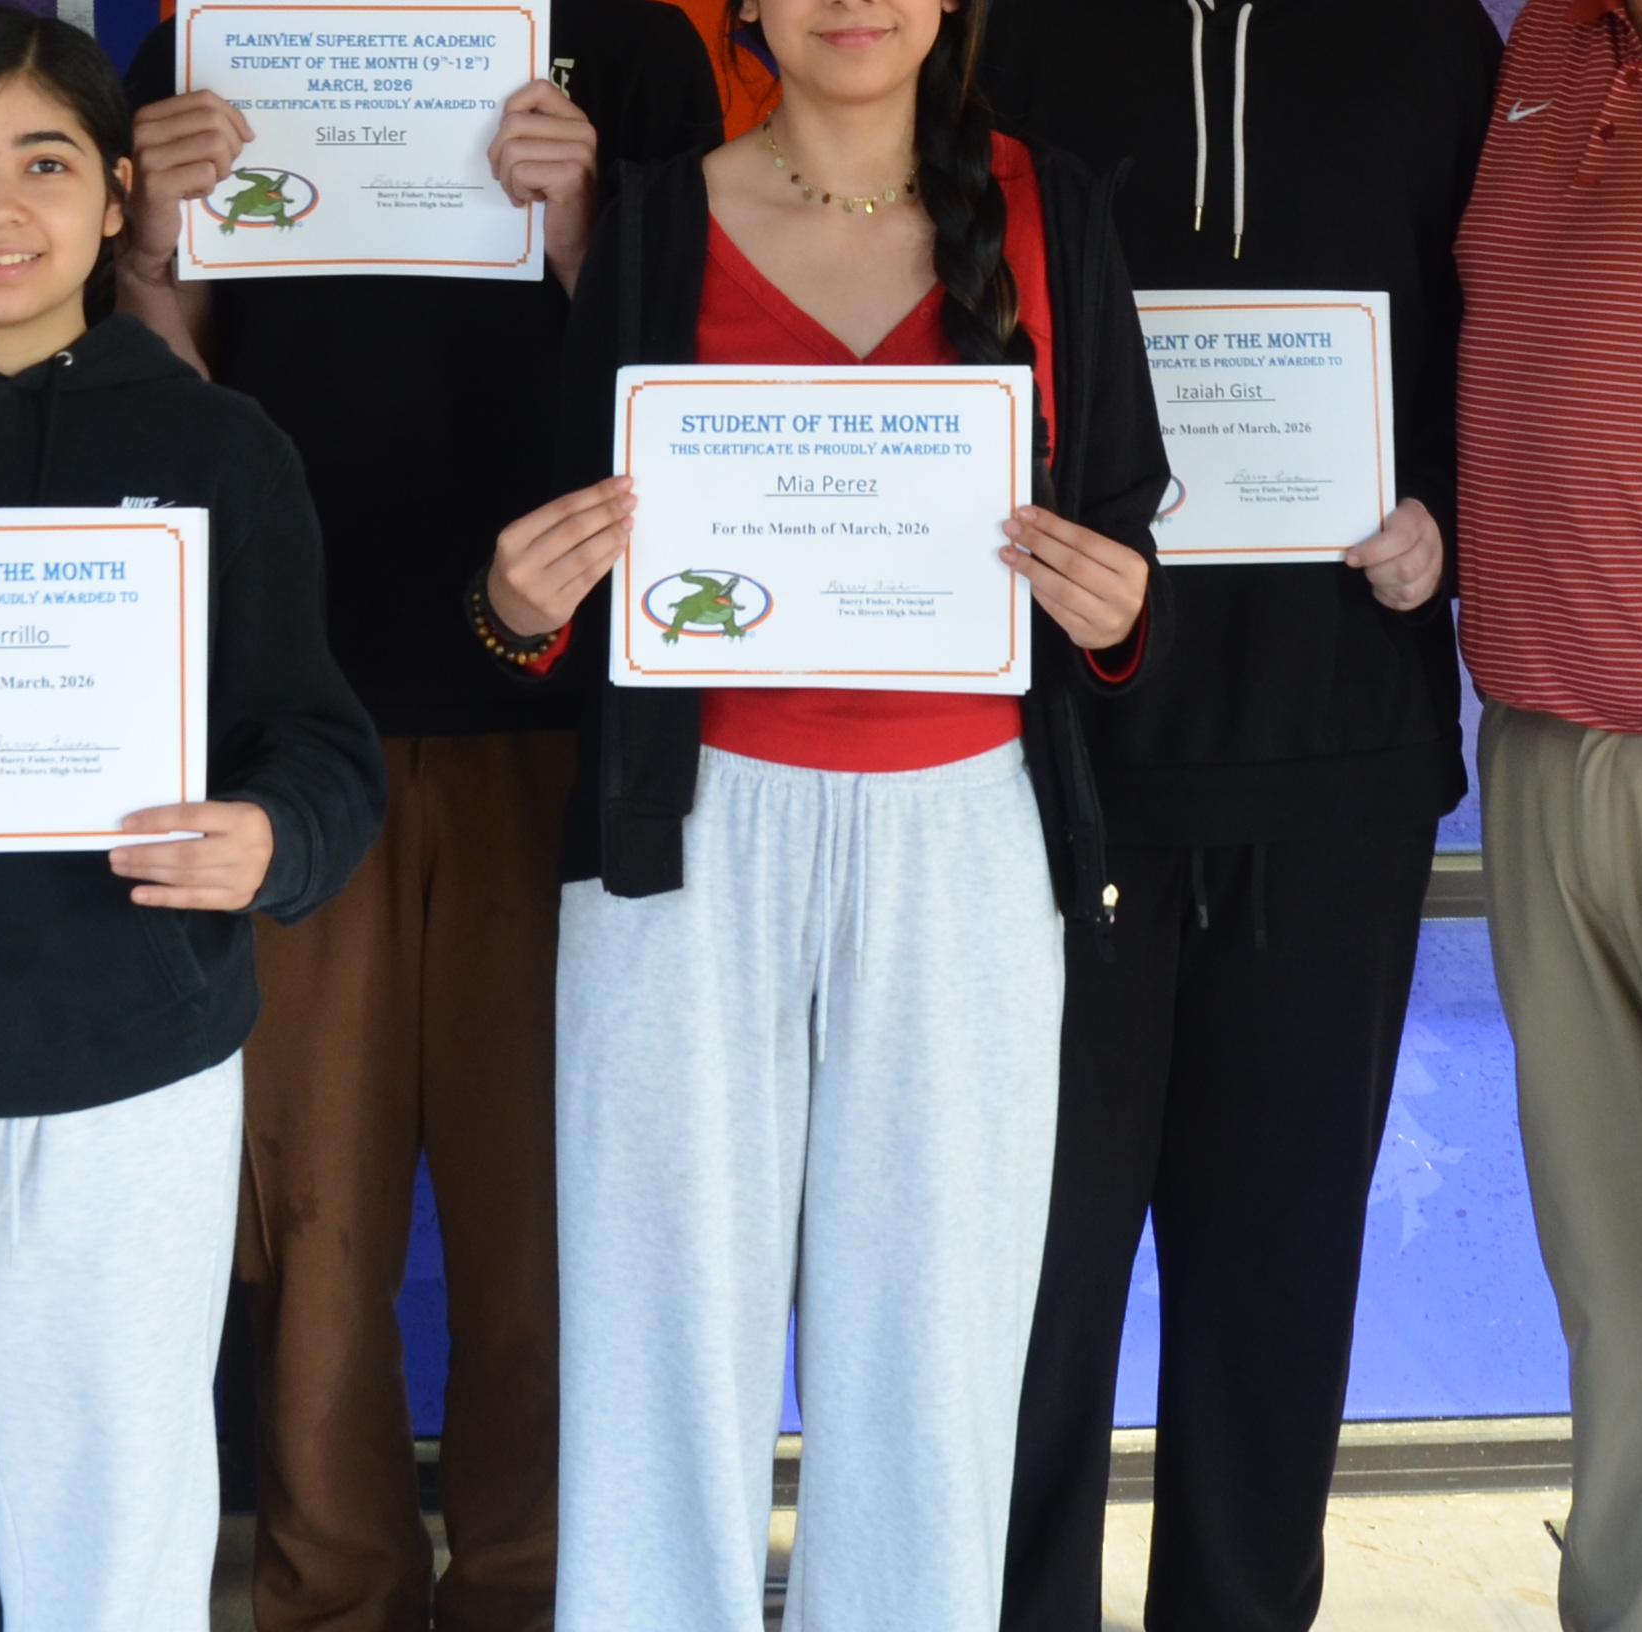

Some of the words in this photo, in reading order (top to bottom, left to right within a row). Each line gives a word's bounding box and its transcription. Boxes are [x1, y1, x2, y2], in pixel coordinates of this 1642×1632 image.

[225, 33, 313, 48] PLAINVIEW
[316, 34, 408, 48] SUPERETTE
[412, 34, 496, 47] ACADEMIC
[230, 55, 302, 71] STUDENT
[306, 55, 325, 70] OF
[329, 56, 361, 70] THE
[365, 56, 418, 70] MONTH
[307, 79, 368, 93] MARCH,
[373, 79, 413, 92] 2026
[255, 99, 337, 110] CERTIFICATE
[340, 100, 351, 109] IS
[354, 98, 411, 110] PROUDLY
[414, 98, 476, 110] AWARDED
[479, 100, 496, 110] TO
[316, 126, 355, 142] Silas
[361, 127, 406, 145] Tyler
[1195, 334, 1218, 350] OF
[1224, 333, 1262, 348] THE
[1267, 333, 1332, 349] MONTH
[1200, 358, 1211, 368] IS
[1214, 356, 1266, 367] PROUDLY
[1268, 356, 1325, 367] AWARDED
[1329, 356, 1342, 366] TO
[1177, 384, 1224, 400] Izaiah
[1230, 383, 1262, 398] Gist
[681, 415, 786, 433] STUDENT
[792, 415, 821, 433] OF
[828, 415, 873, 433] THE
[880, 415, 960, 433] MONTH
[1162, 425, 1176, 435] he
[1180, 424, 1219, 435] Month
[1222, 423, 1234, 435] of
[1238, 423, 1281, 435] March,
[1285, 423, 1311, 433] 2026
[670, 443, 700, 455] THIS
[704, 443, 794, 455] CERTIFICATE
[798, 443, 810, 455] IS
[814, 442, 877, 455] PROUDLY
[880, 442, 951, 455] AWARDED
[954, 443, 972, 455] TO
[776, 475, 815, 492] Mia
[822, 475, 877, 493] Perez
[712, 523, 737, 535] For
[742, 523, 764, 535] the
[769, 523, 817, 535] Month
[821, 522, 836, 535] of
[840, 522, 892, 537] March,
[897, 522, 930, 535] 2026
[43, 561, 126, 581] MONTH
[42, 591, 116, 604] AWARDED
[120, 591, 138, 603] TO
[0, 676, 55, 690] March,
[60, 675, 95, 689] 2026
